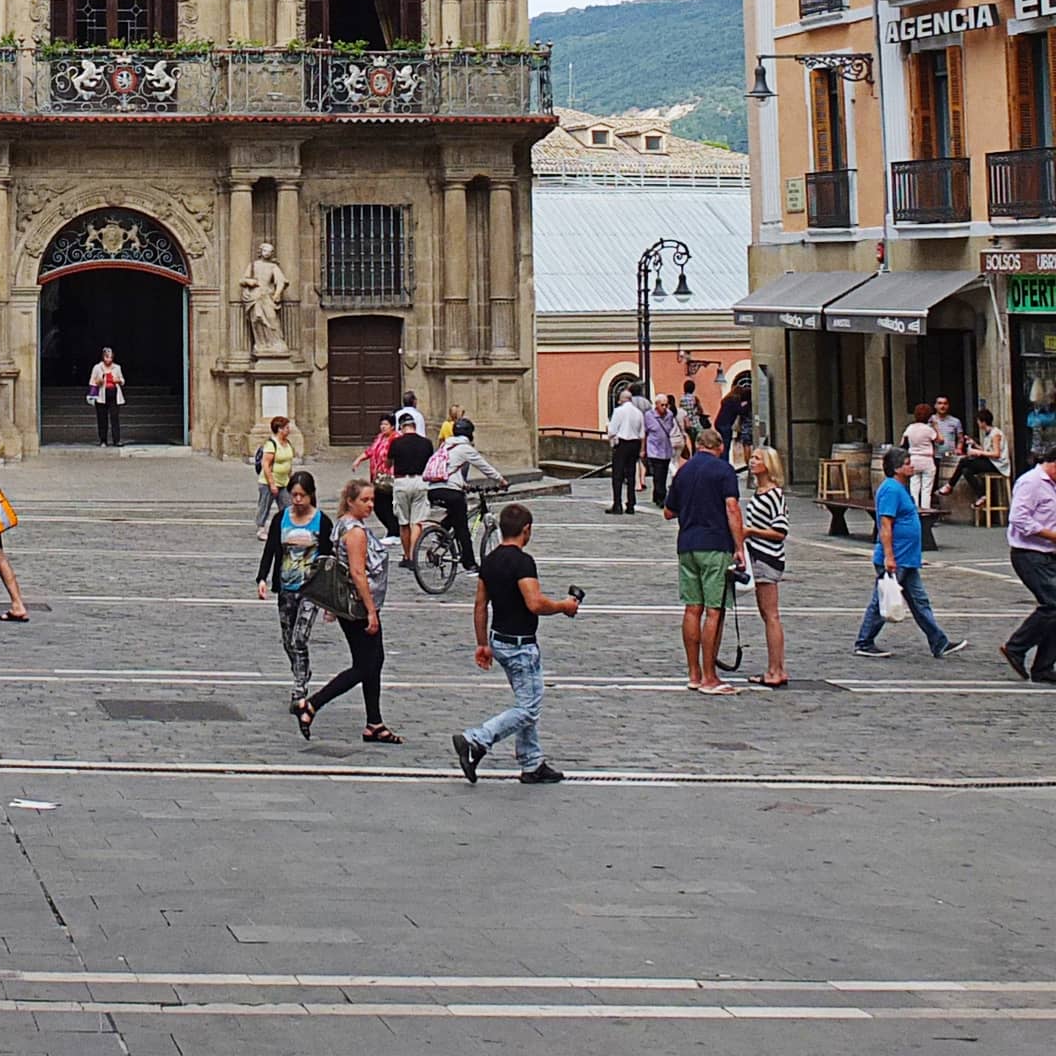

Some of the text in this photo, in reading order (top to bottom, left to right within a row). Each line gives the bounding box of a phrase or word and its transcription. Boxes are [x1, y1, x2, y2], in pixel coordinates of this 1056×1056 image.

[886, 5, 994, 43] AGENCIA
[985, 254, 1021, 270] BOLSOS
[1011, 279, 1056, 308] OFERT
